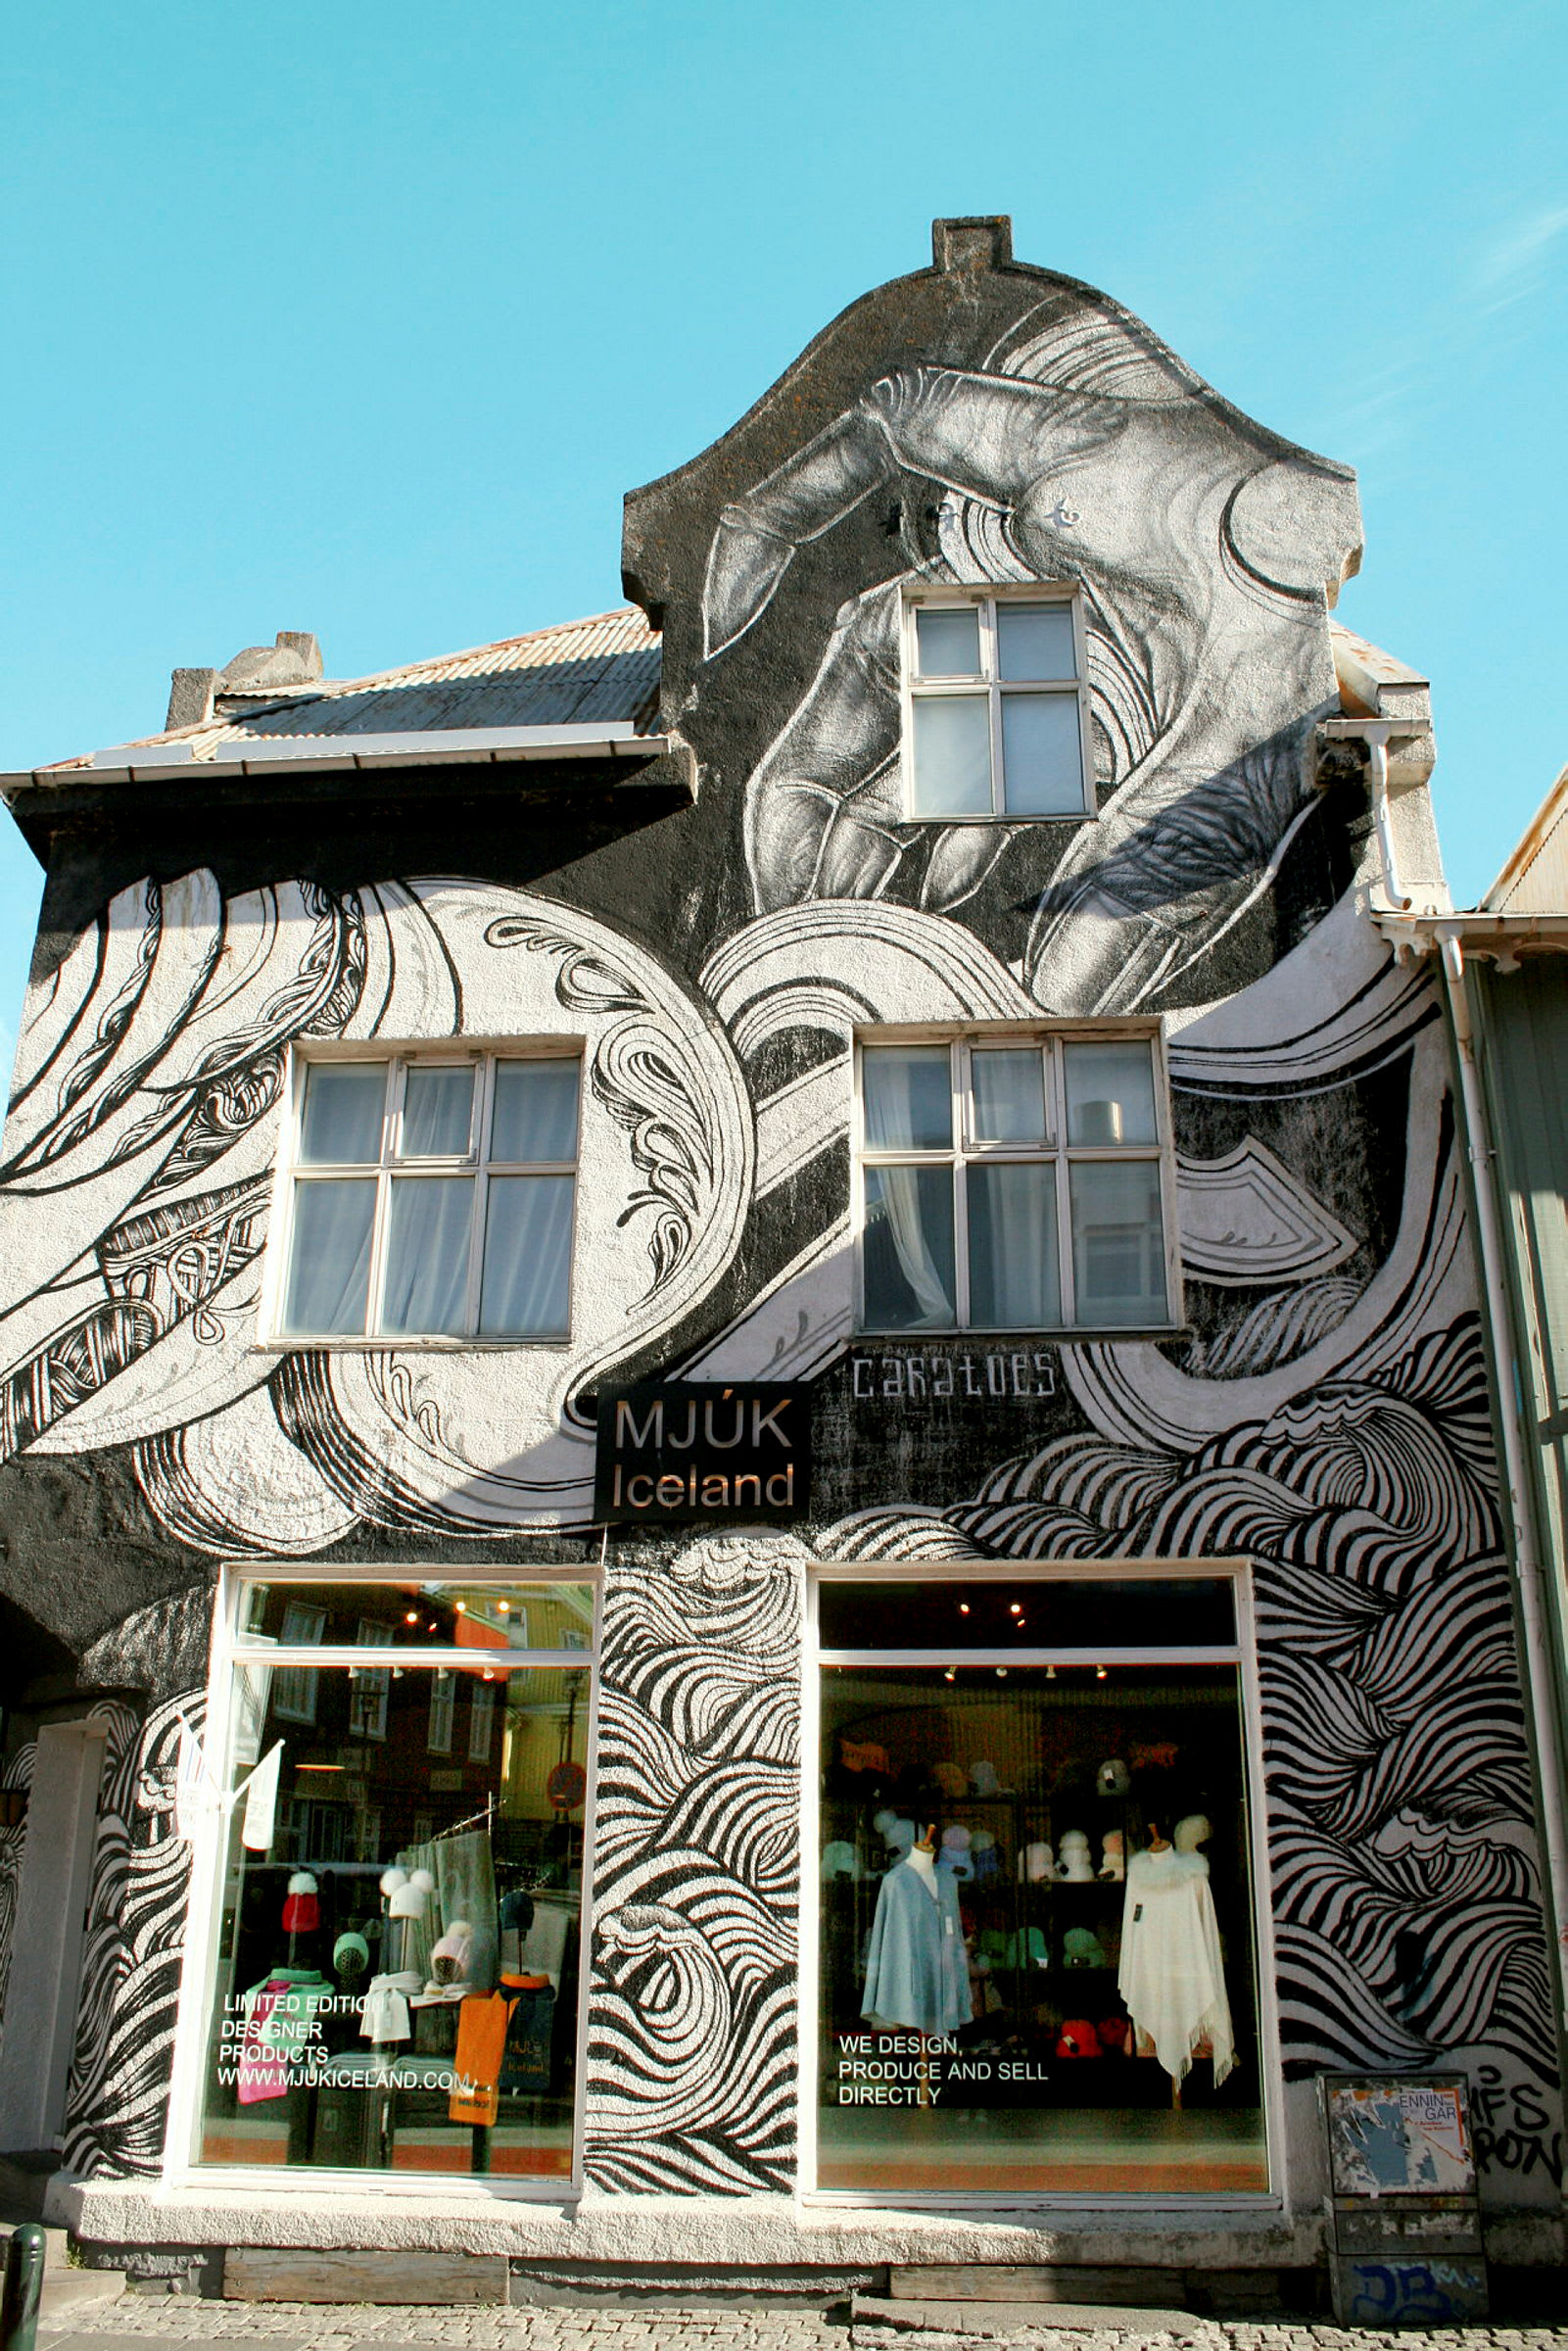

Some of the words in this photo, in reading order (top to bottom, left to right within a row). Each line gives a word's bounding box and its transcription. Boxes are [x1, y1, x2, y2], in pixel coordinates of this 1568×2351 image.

[615, 1388, 793, 1450] MJÚK
[612, 1463, 794, 1509] Iceland
[223, 1993, 300, 2012] LIMITED
[220, 2020, 323, 2039] DESIGNER
[219, 2044, 329, 2064] PRODUCTS
[838, 2035, 872, 2054] WE
[879, 2036, 963, 2057] DESIGN,
[216, 2067, 469, 2089] WWW.MJUKICELAND.COM
[838, 2061, 941, 2081] PRODUCE
[947, 2062, 992, 2081] AND
[997, 2062, 1049, 2081] SELL
[838, 2087, 942, 2105] DIRECTLY
